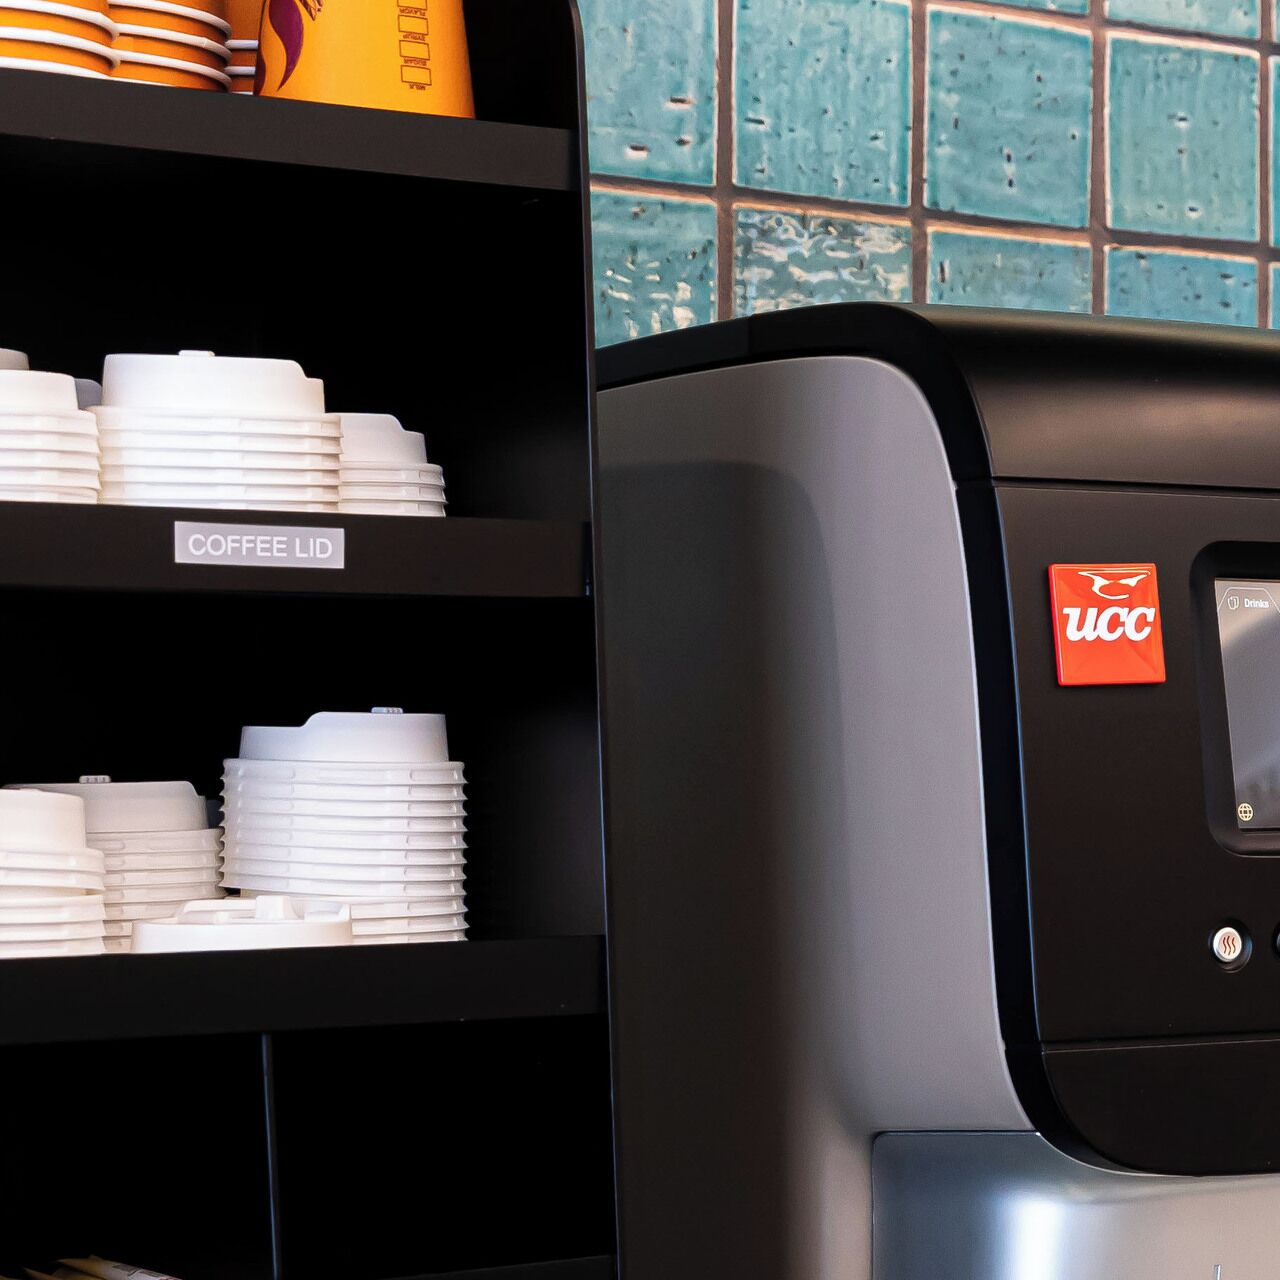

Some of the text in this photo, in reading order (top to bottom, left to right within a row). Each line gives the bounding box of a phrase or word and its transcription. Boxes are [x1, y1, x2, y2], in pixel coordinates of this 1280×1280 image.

[188, 533, 333, 558] COFFEE LID
[1244, 598, 1269, 609] Drinks
